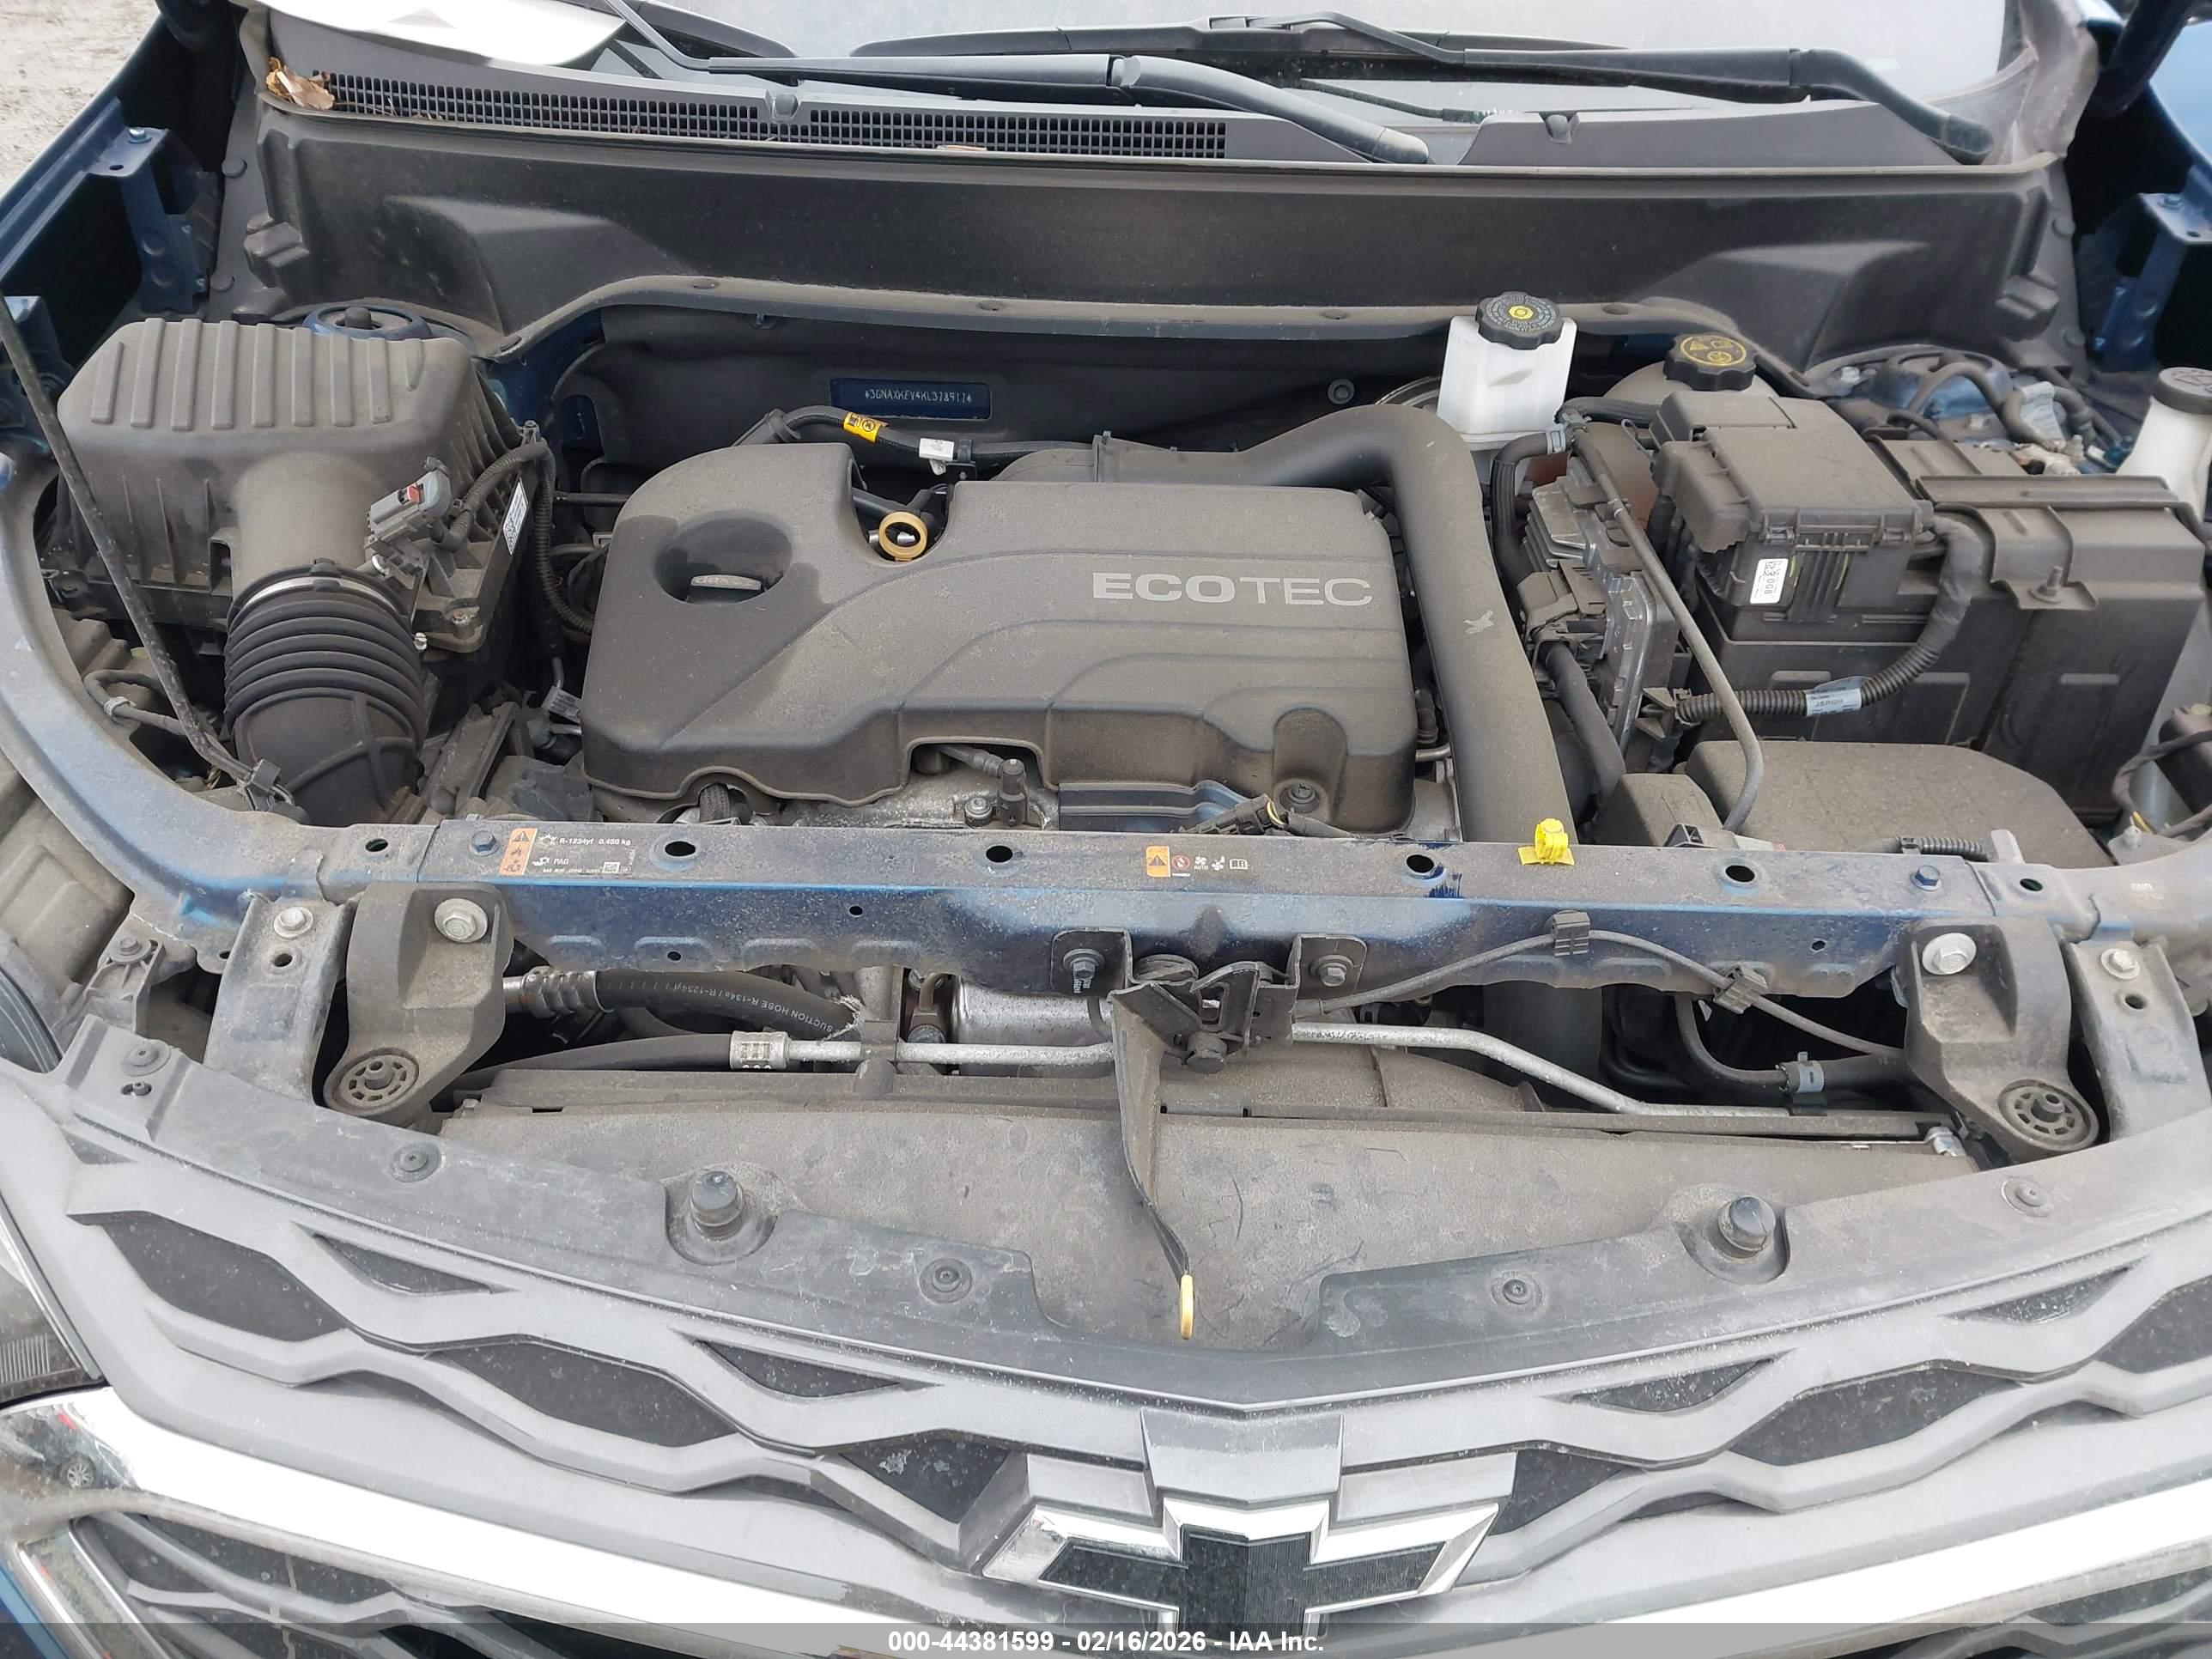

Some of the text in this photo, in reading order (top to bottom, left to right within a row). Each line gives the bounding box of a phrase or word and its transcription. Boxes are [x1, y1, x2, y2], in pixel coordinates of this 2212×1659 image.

[1092, 572, 1373, 606] ECOTEC
[559, 837, 595, 846] R-1234yf
[621, 838, 632, 848] kg
[725, 990, 760, 1007] R-134a
[761, 999, 790, 1015] HOSE
[790, 1009, 834, 1033] SUCTION
